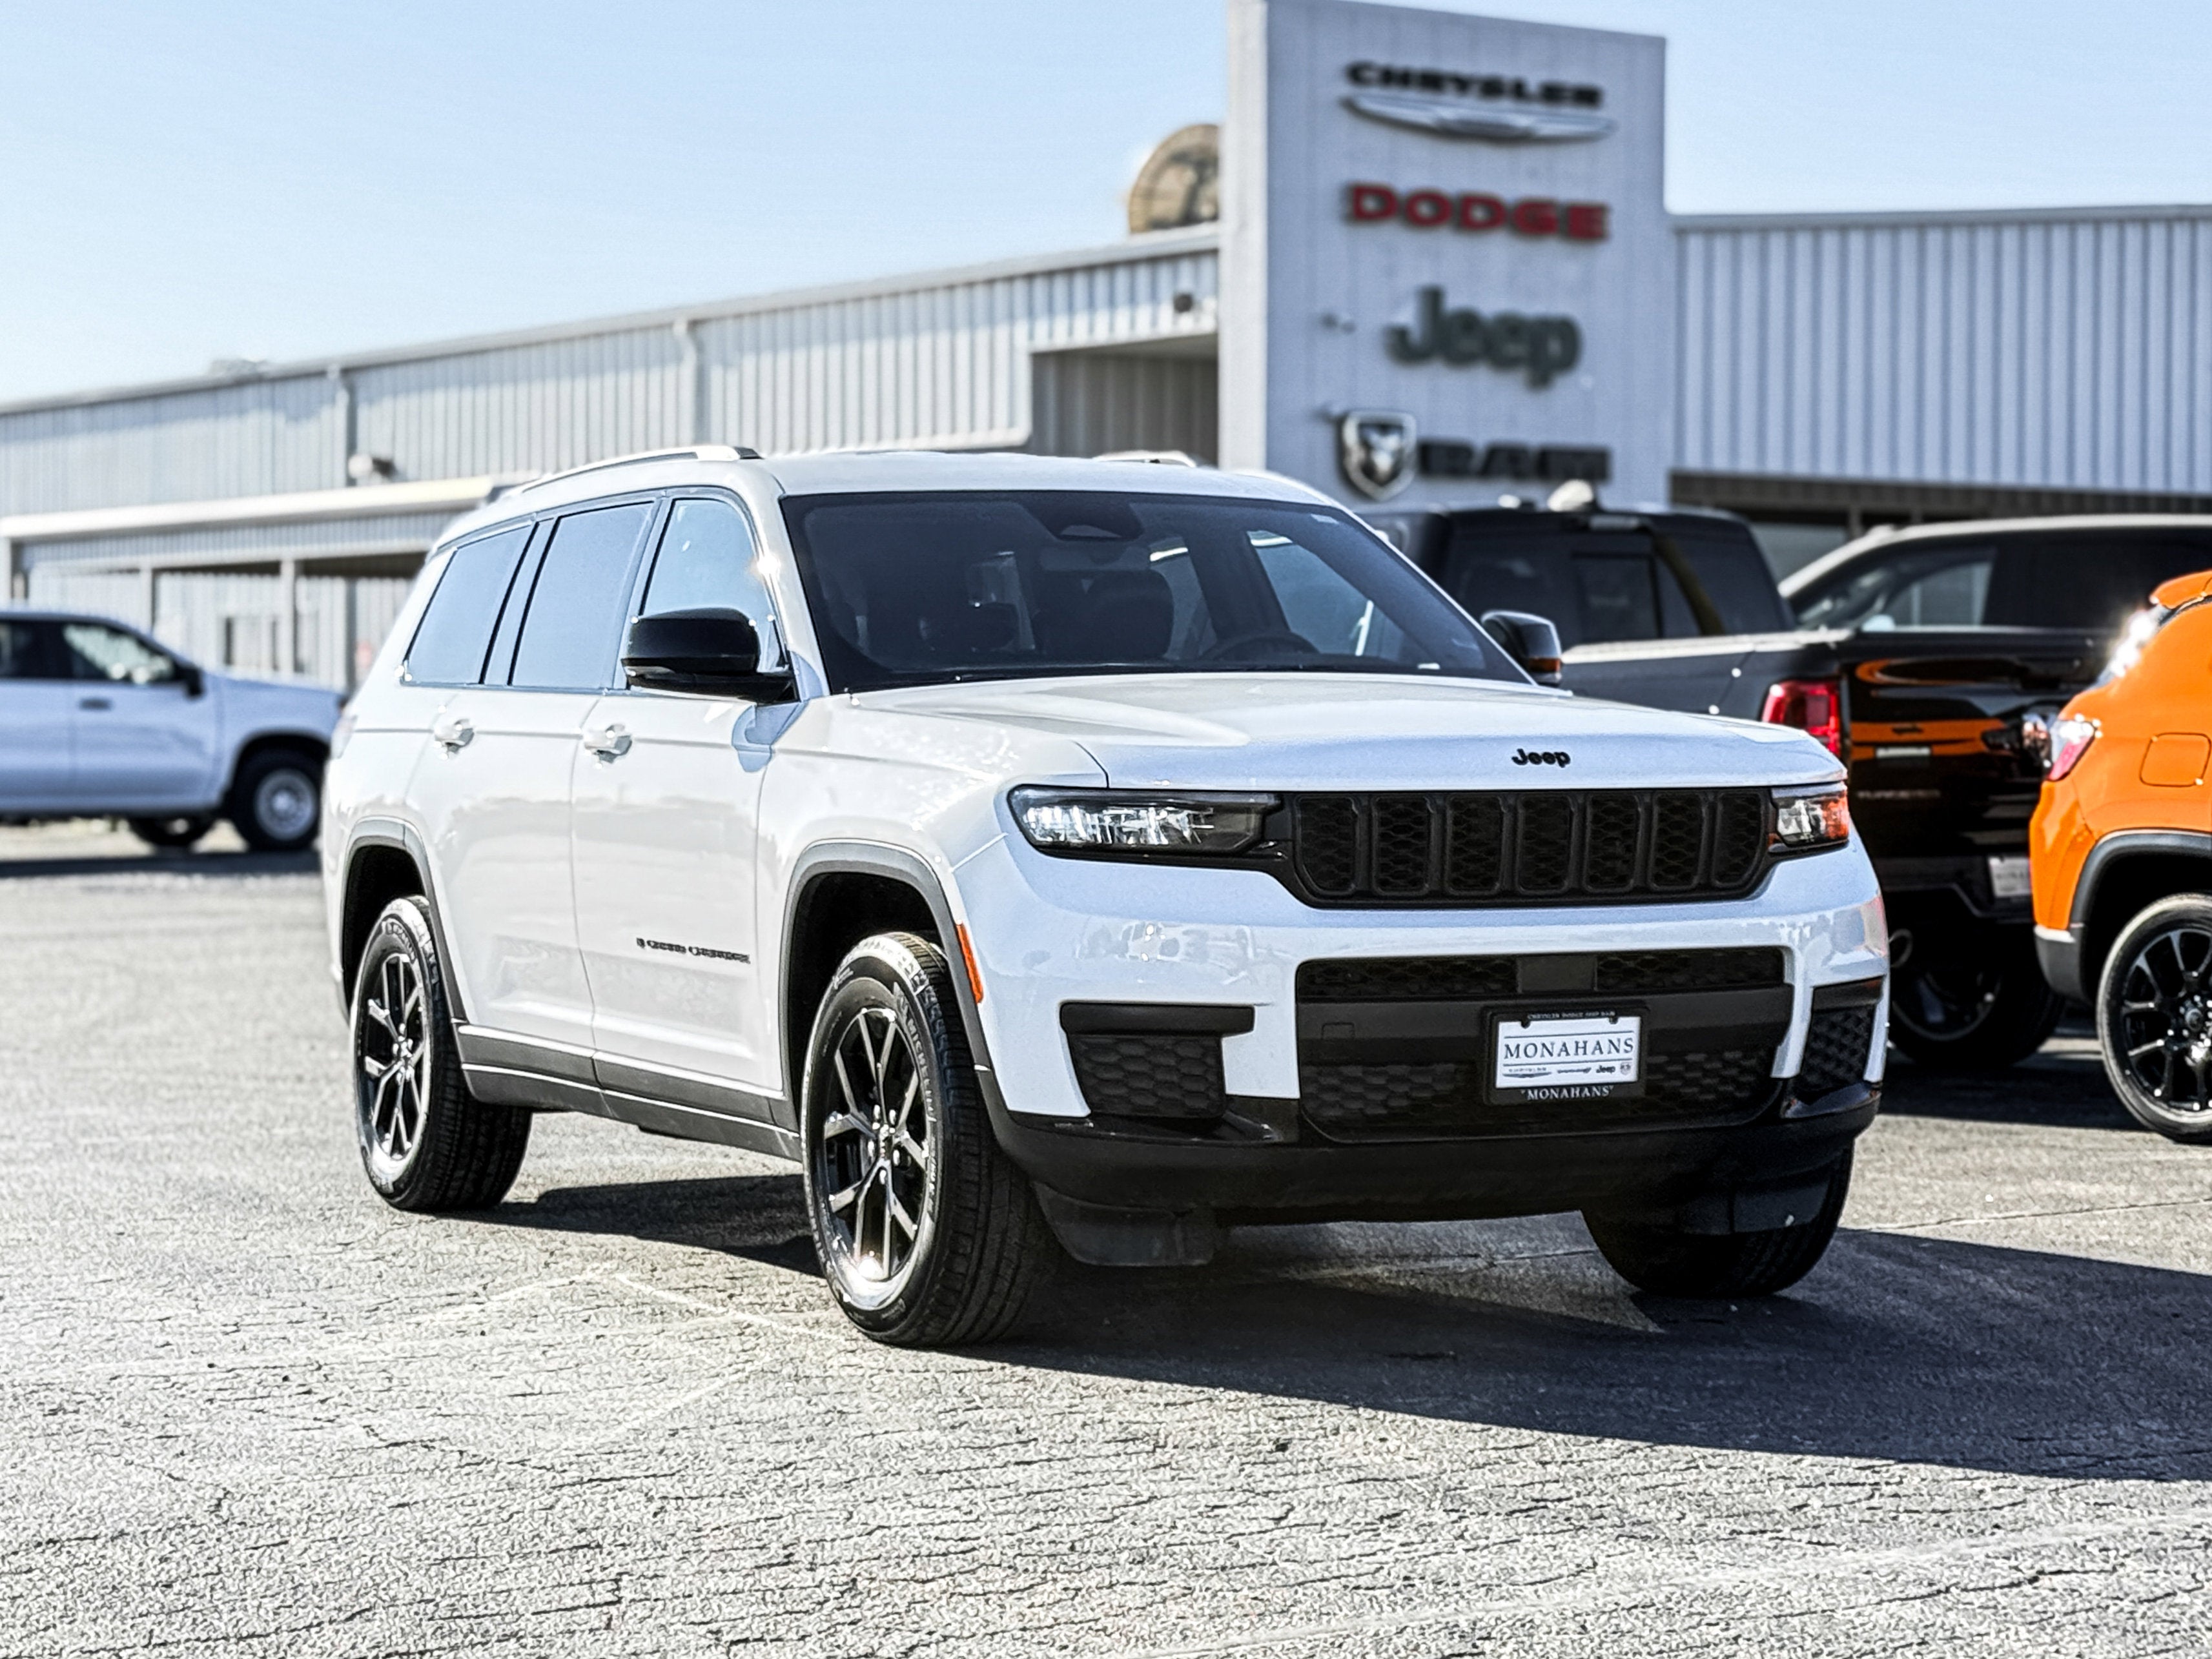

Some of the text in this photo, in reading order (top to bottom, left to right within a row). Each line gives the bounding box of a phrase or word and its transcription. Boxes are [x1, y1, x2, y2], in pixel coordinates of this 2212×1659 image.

[1347, 61, 1604, 107] CHRYSLER
[1346, 183, 1610, 243] DODGE
[1387, 285, 1582, 390] Jeep
[1418, 439, 1612, 482] RAM
[1511, 748, 1571, 768] Jeep
[1504, 1037, 1633, 1059] MONAHANS
[1526, 1086, 1610, 1101] MONAHANS
